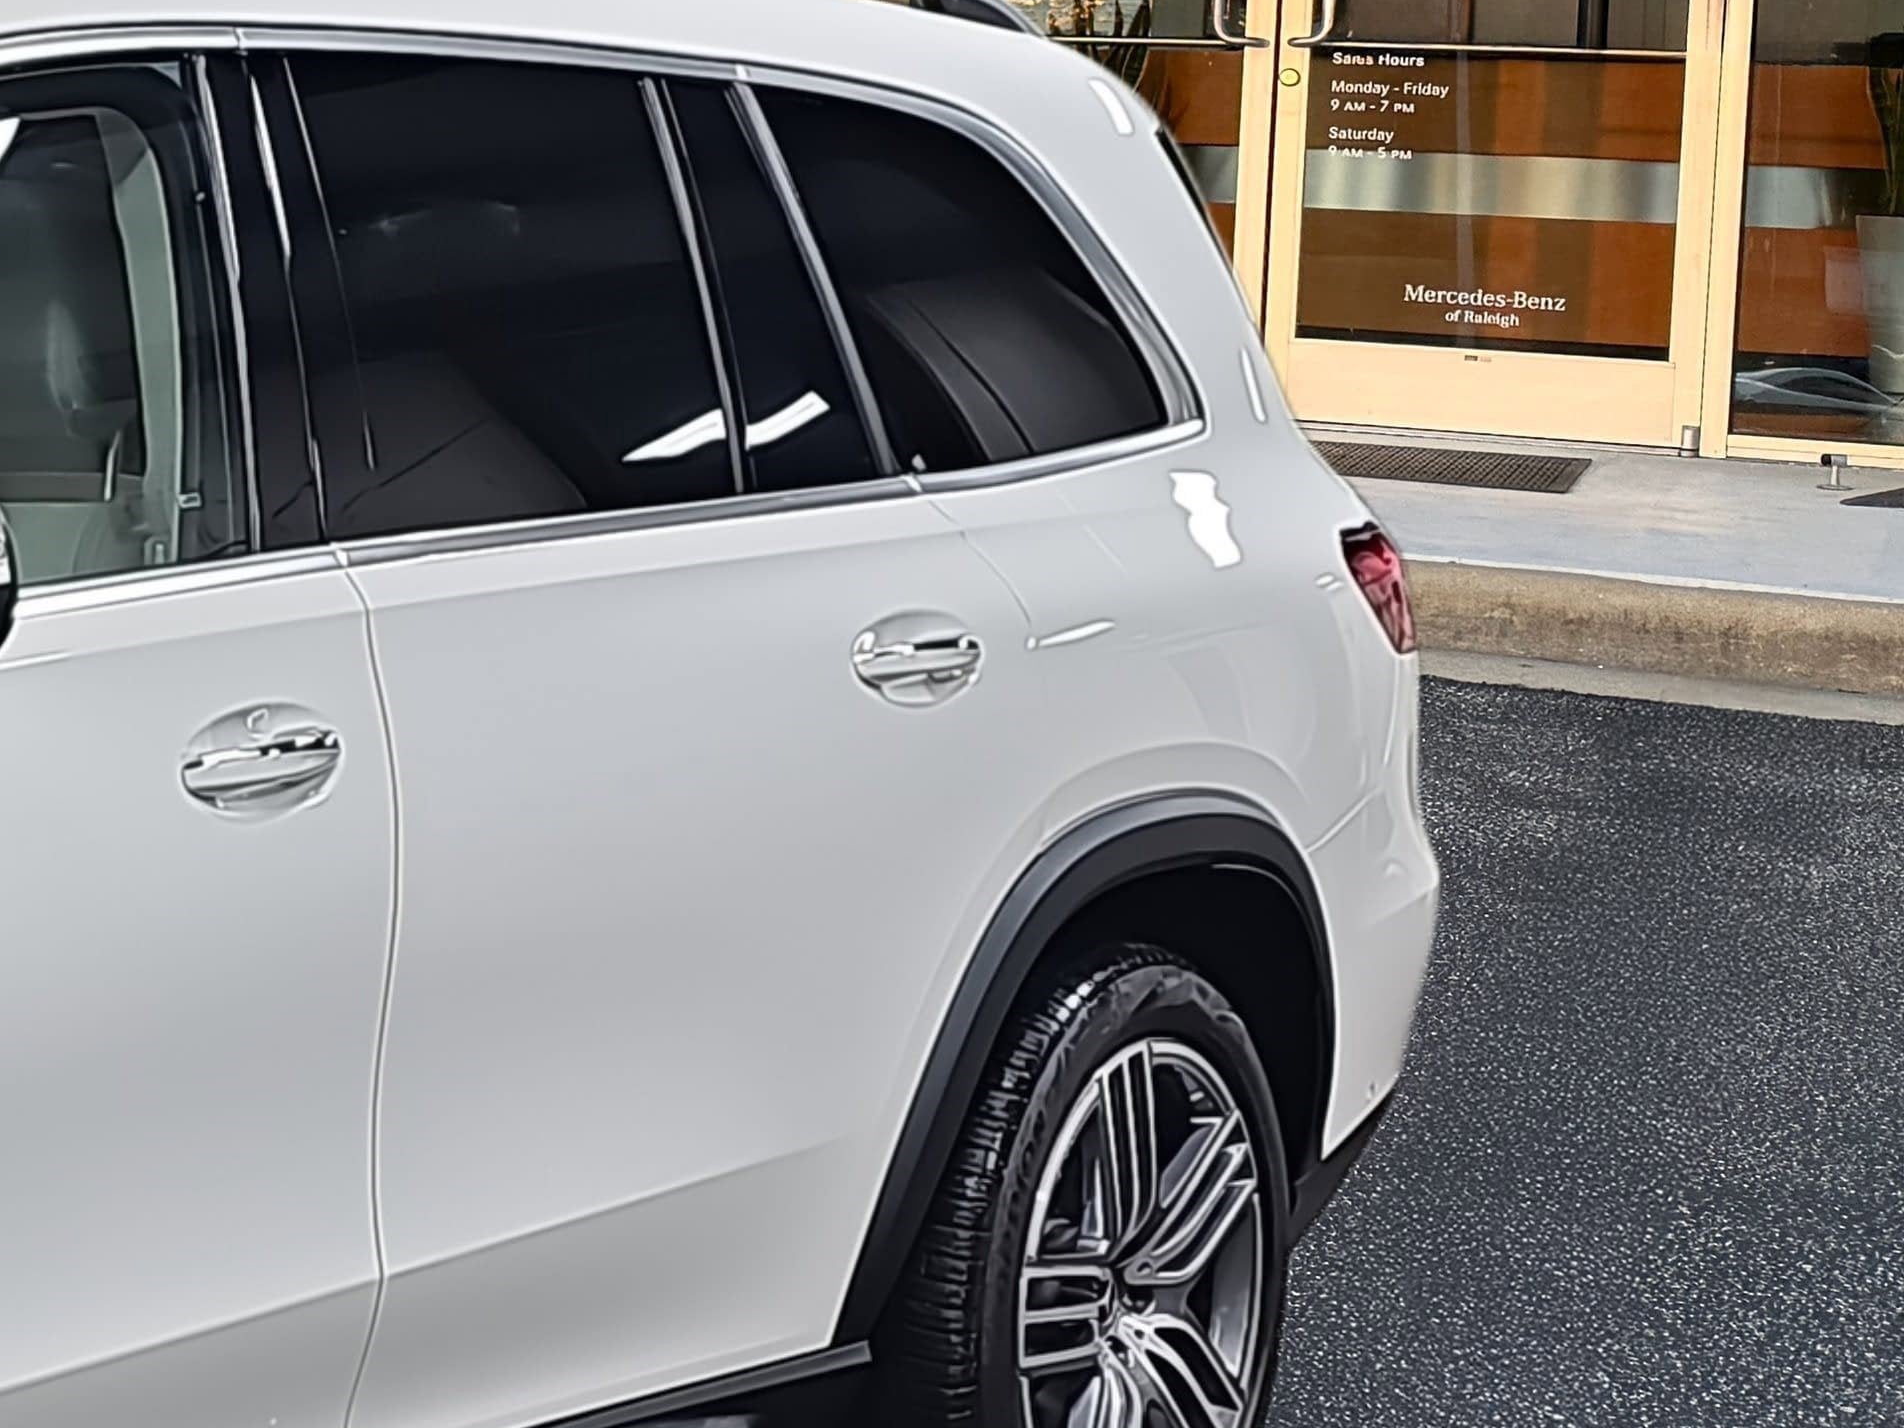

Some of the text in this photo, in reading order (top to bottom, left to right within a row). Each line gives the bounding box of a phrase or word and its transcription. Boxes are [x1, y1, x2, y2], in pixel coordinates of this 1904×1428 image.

[1378, 52, 1425, 67] Hours
[1331, 80, 1390, 97] Monday
[1403, 82, 1450, 99] Friday
[1330, 98, 1340, 111] 9
[1343, 101, 1366, 112] AM
[1380, 100, 1389, 112] 7
[1393, 103, 1415, 113] PM
[1328, 126, 1394, 144] Saturday
[1328, 145, 1338, 158] 9
[1341, 148, 1364, 158] AM
[1377, 147, 1386, 159] 5
[1391, 149, 1413, 160] PM
[1403, 283, 1566, 312] Mercedes-Benz
[1445, 309, 1520, 329] of Raleigh
